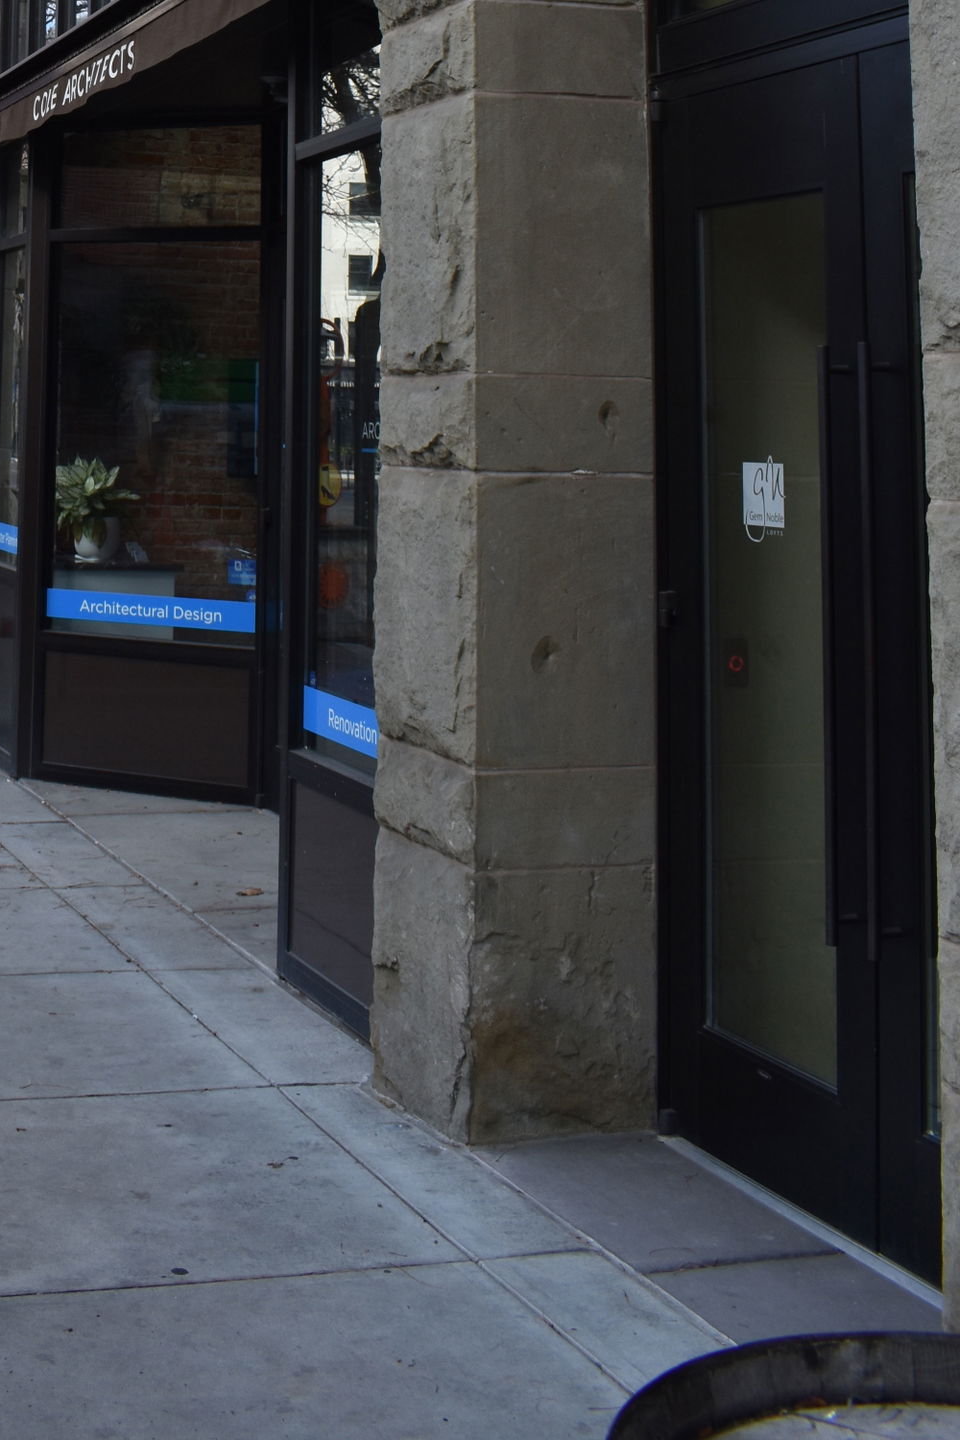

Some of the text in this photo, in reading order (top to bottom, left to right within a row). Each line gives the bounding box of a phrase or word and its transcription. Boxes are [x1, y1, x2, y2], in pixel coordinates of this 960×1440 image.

[62, 40, 135, 107] ARCHITECTS
[749, 510, 763, 521] Gem
[79, 599, 222, 624] Architectural Design
[328, 708, 377, 745] Renovation
